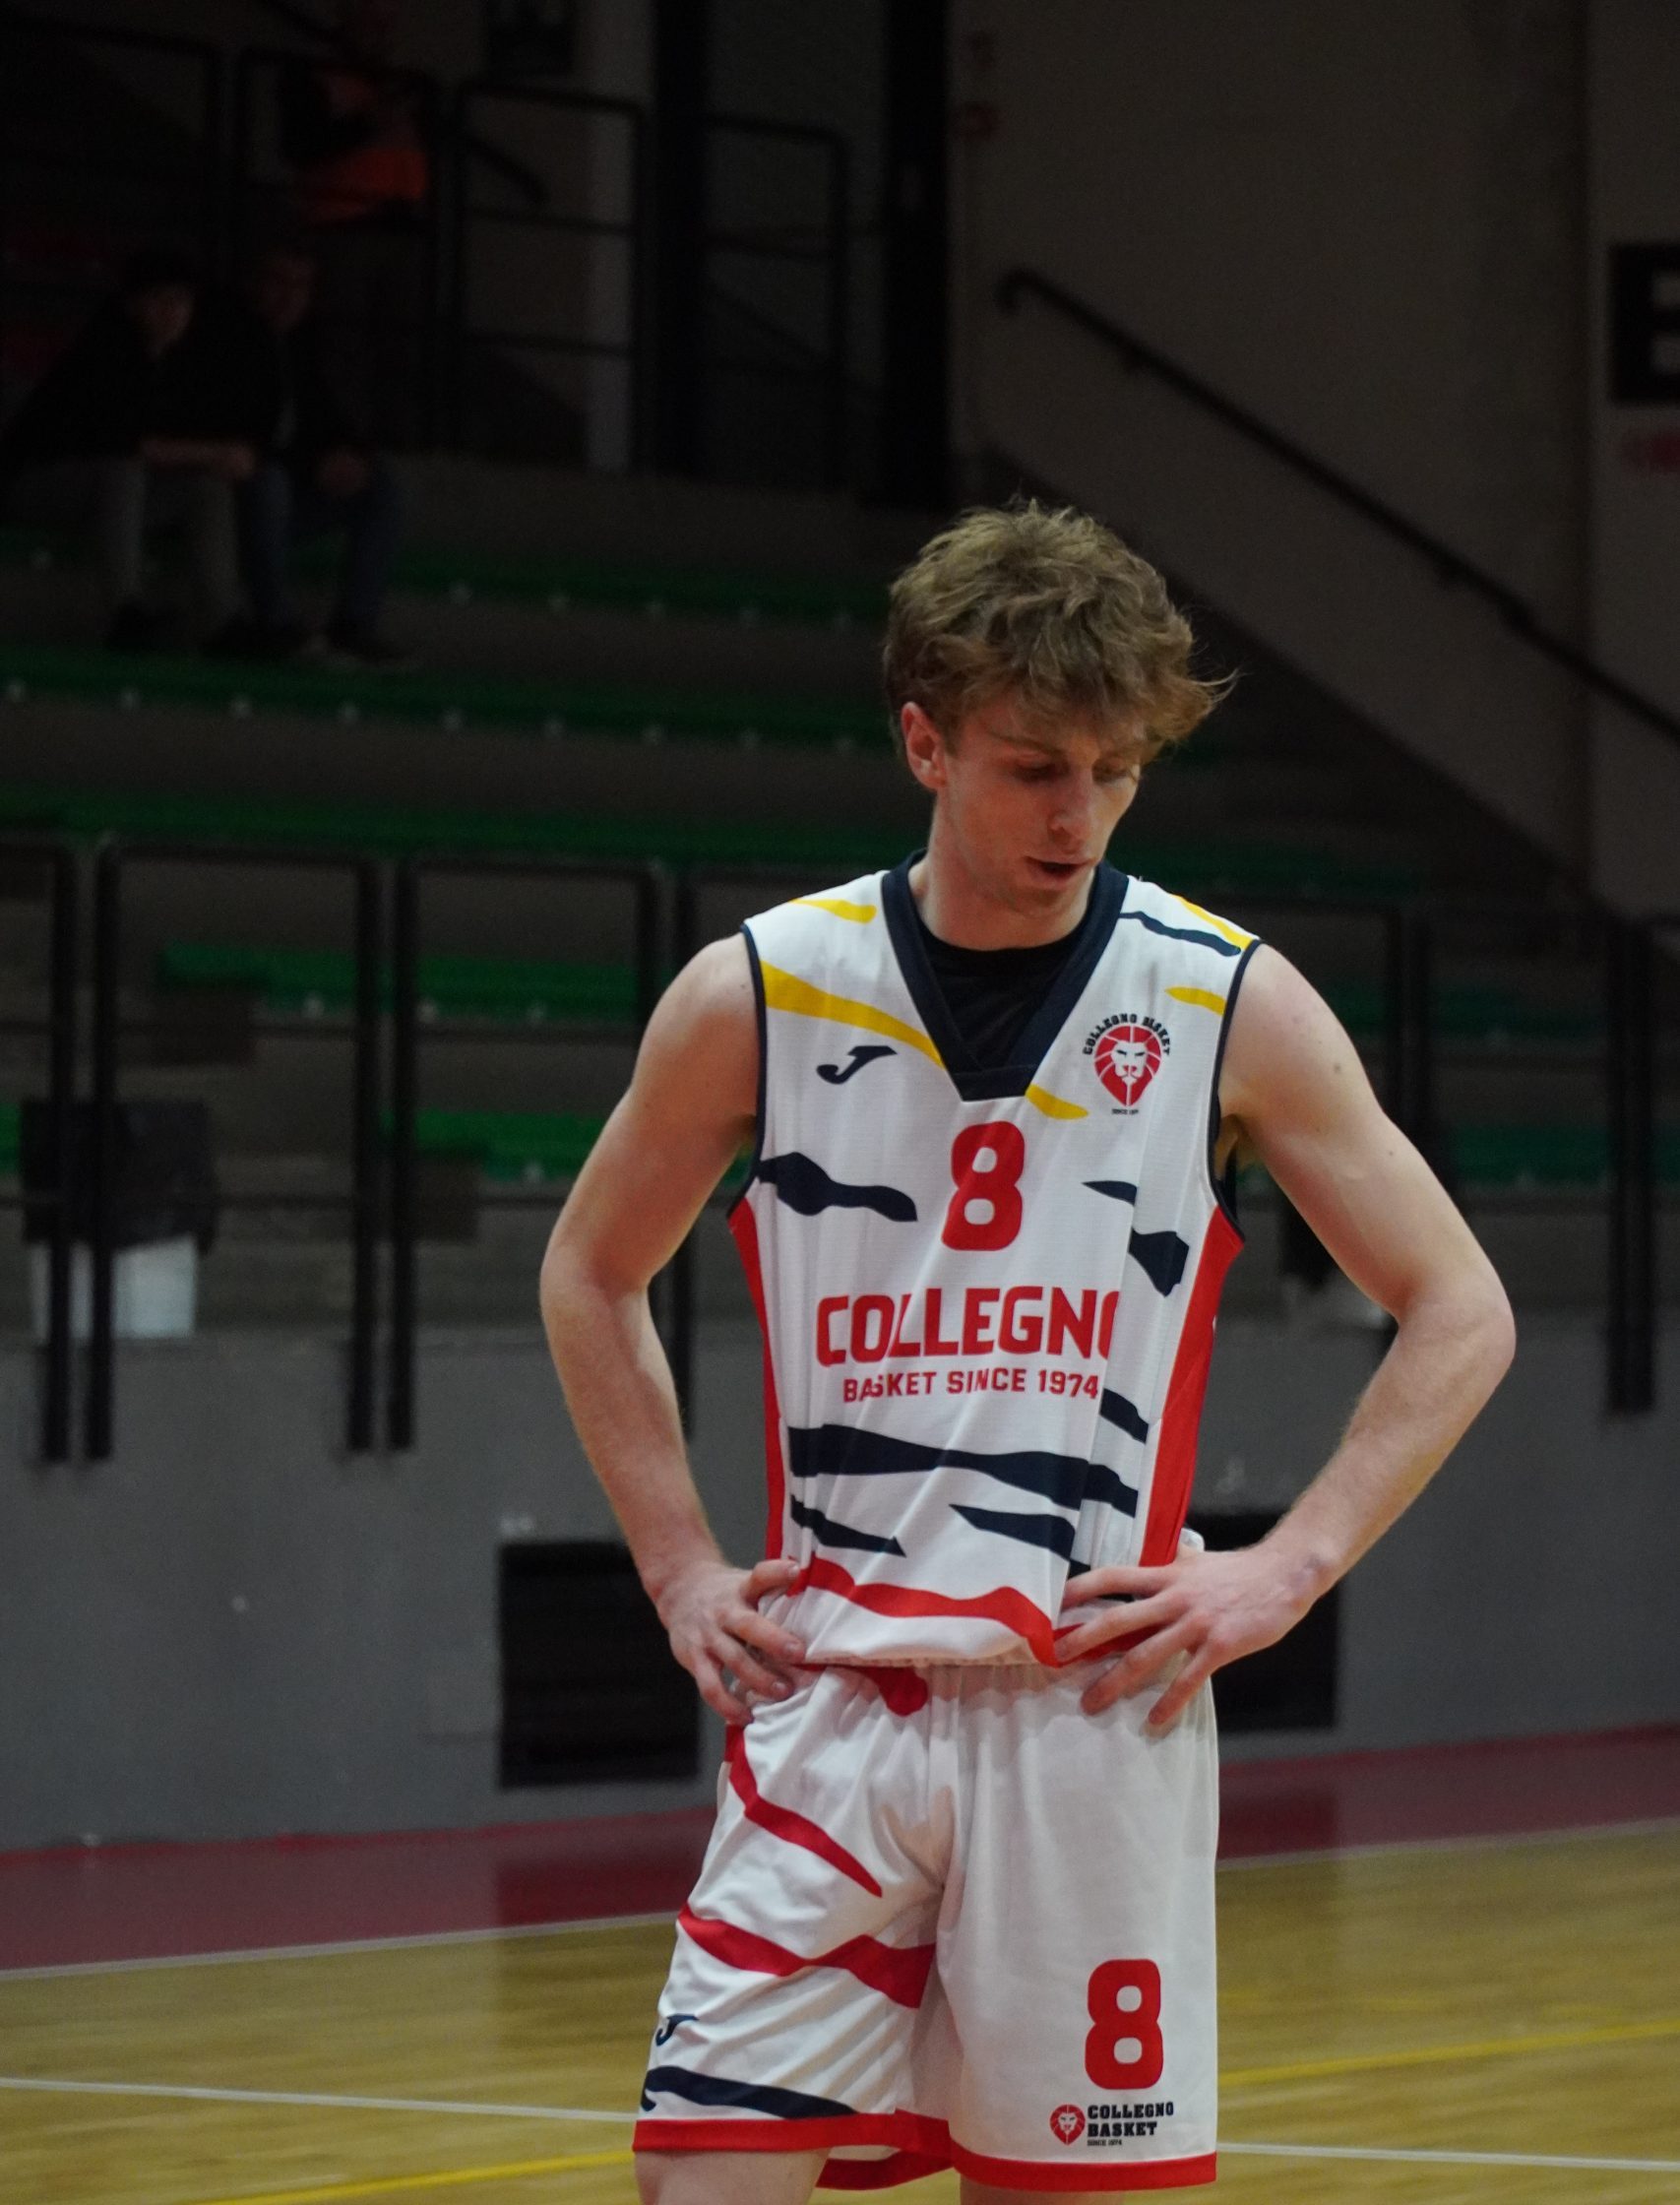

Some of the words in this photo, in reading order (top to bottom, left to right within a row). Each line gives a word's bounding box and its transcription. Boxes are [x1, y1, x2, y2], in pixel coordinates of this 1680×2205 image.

[1083, 1014, 1138, 1055] COLLEGNO
[941, 1120, 1026, 1251] 8
[947, 1367, 1027, 1394] SINCE
[1038, 1369, 1098, 1400] 1974
[1085, 1959, 1164, 2090] 8
[1087, 2102, 1174, 2119] COLLEGNO
[1087, 2121, 1157, 2137] BASKET
